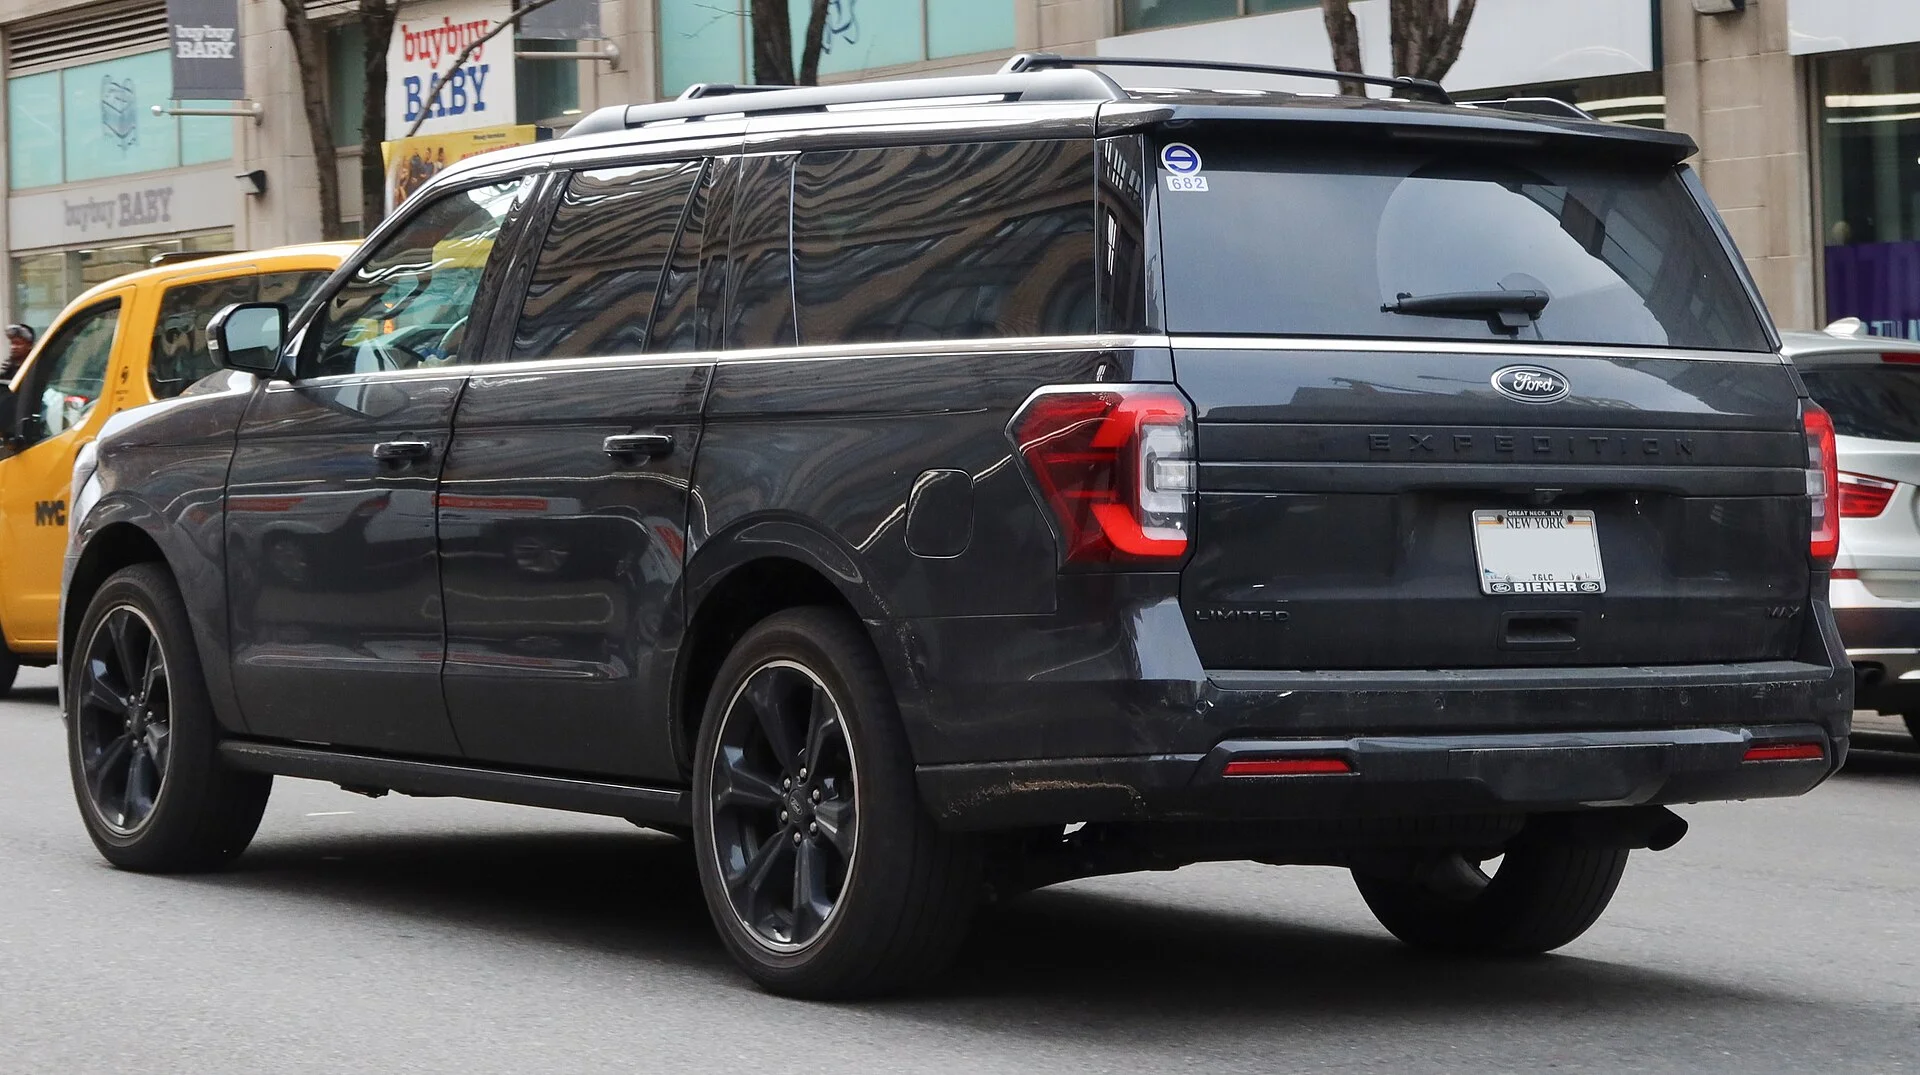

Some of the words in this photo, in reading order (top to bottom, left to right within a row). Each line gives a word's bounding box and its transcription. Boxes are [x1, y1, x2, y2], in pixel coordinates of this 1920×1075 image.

[174, 25, 235, 41] buybuy
[175, 42, 236, 58] BABY
[402, 17, 488, 69] buybuy
[404, 64, 489, 122] BABY
[1172, 177, 1205, 190] 682
[64, 196, 117, 232] buybuy
[118, 187, 173, 227] BABY
[1512, 371, 1554, 393] Ford
[1368, 433, 1693, 456] EXPEDITION
[35, 500, 66, 526] NYC
[1506, 518, 1531, 529] NEW
[1535, 518, 1565, 529] YORK
[1532, 573, 1554, 581] T&LC
[1513, 582, 1577, 592] BIENER
[1195, 610, 1290, 621] LIMITED
